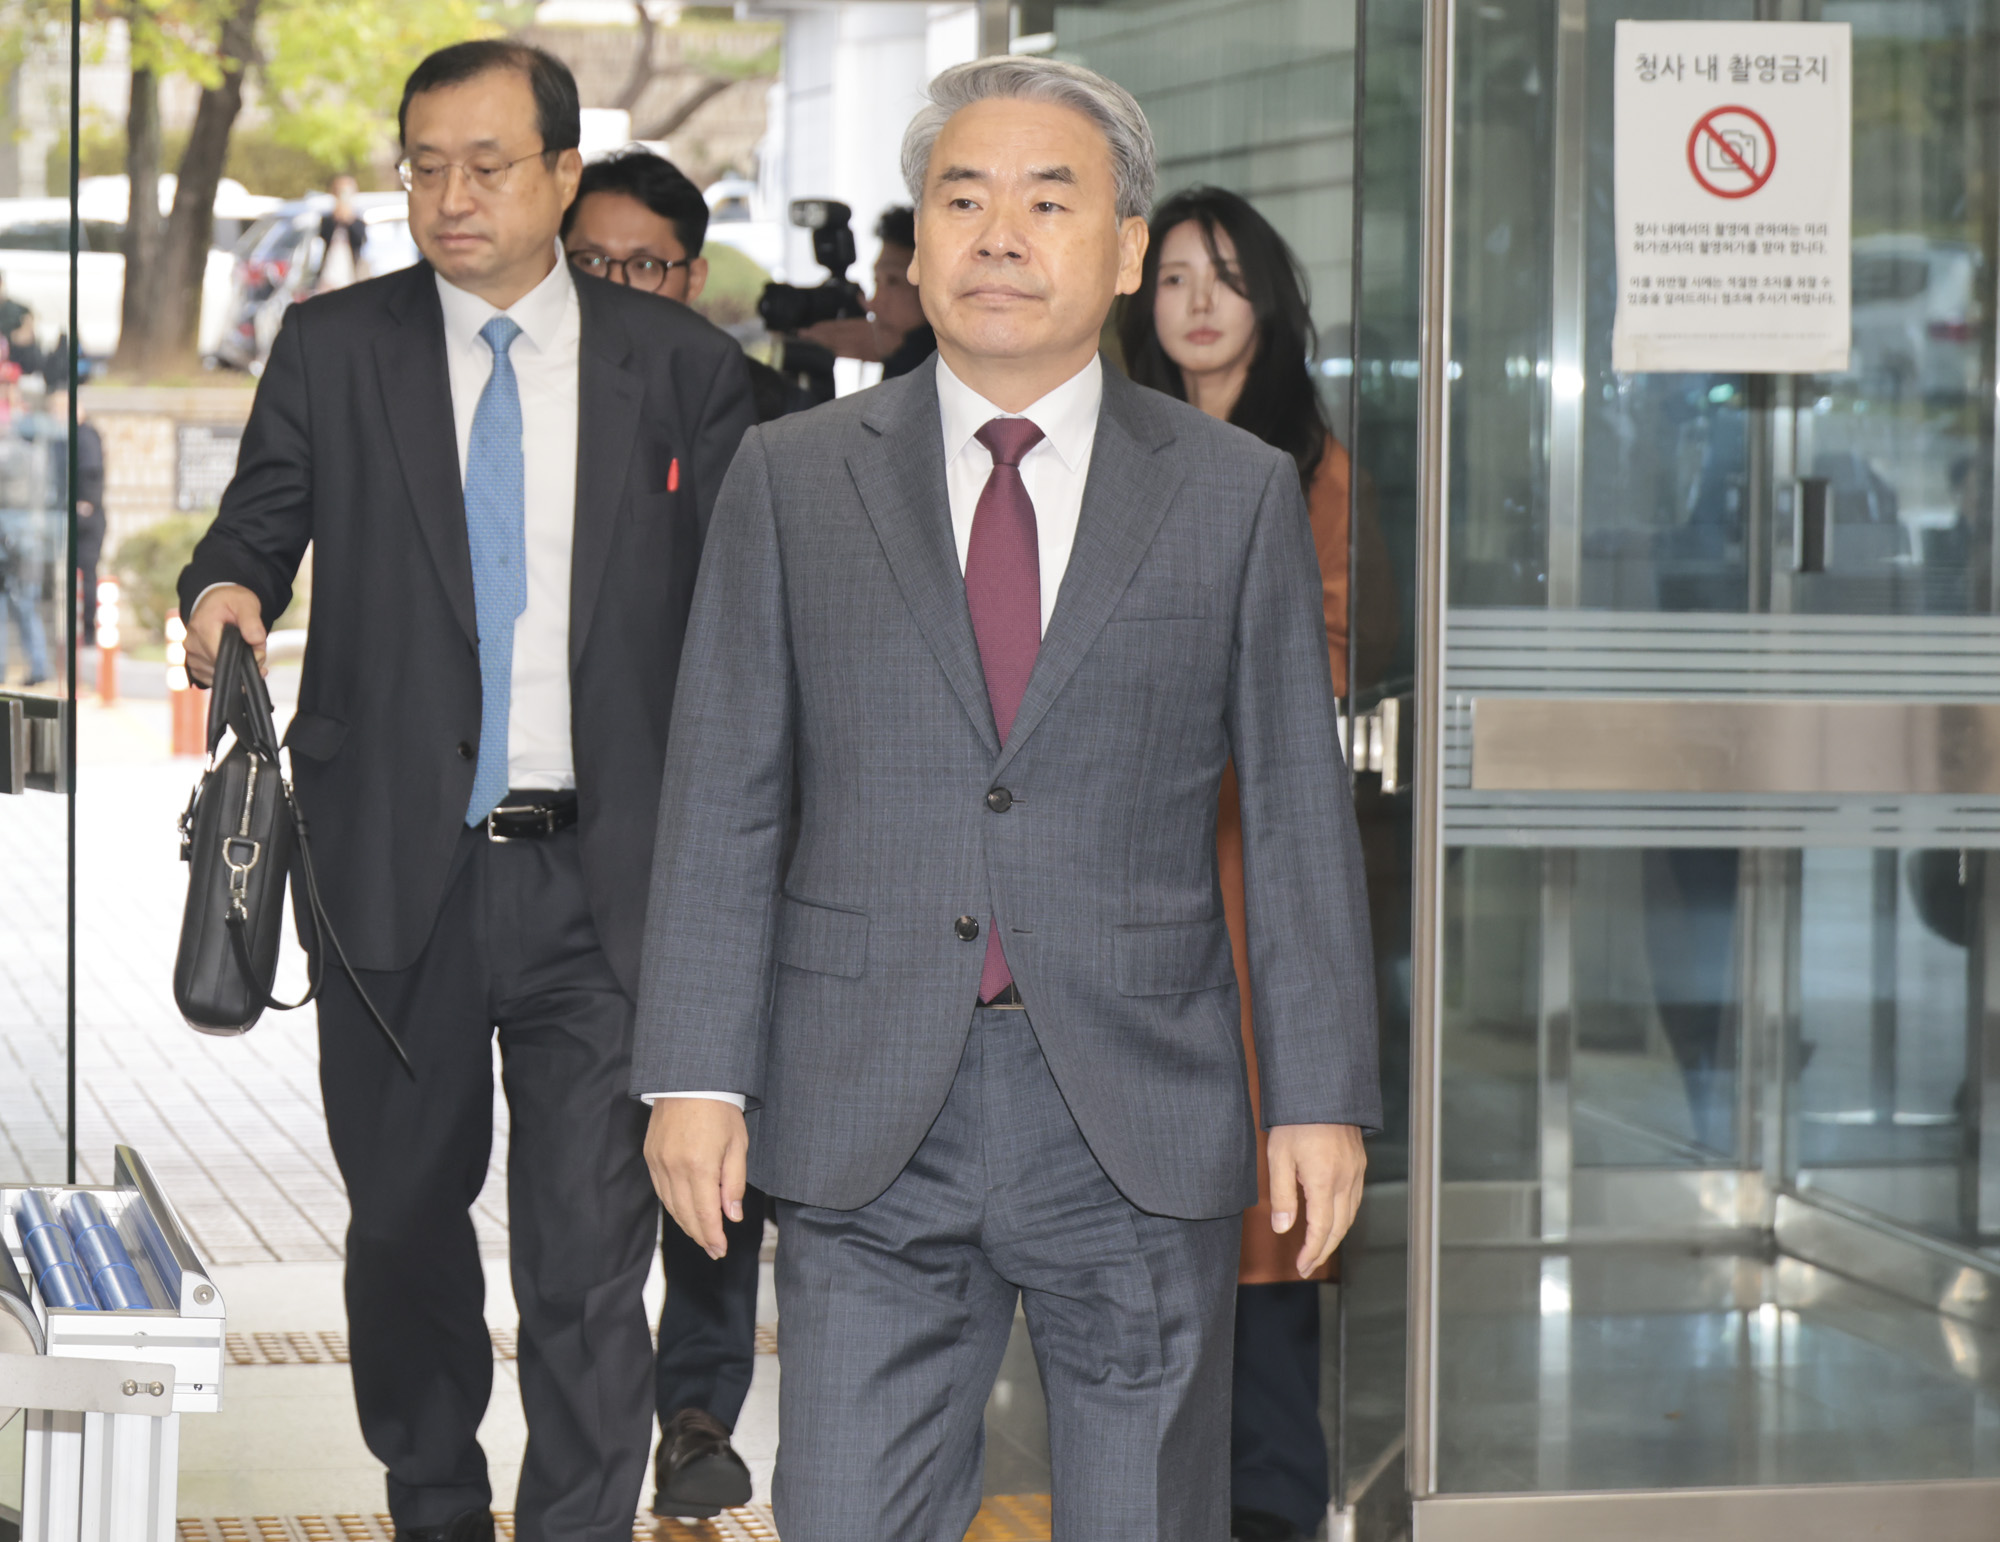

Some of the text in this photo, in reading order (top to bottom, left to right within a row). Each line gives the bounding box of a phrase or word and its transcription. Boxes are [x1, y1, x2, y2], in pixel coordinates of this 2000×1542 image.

[1635, 54, 1828, 84] 청사 내 촬영금지
[1634, 222, 1828, 236] 청사 내에서의 촬영에 관하여는 미리
[1699, 241, 1757, 254] 촬영허가를
[1762, 241, 1785, 254] 받아
[1790, 241, 1828, 254] 합니다.
[1630, 276, 1832, 288] 이를 위반할 시에는 적절한 조치를 취할 수
[1627, 292, 1836, 304] 있음을 알려드리니 협조해 주시기 바랍니다.
